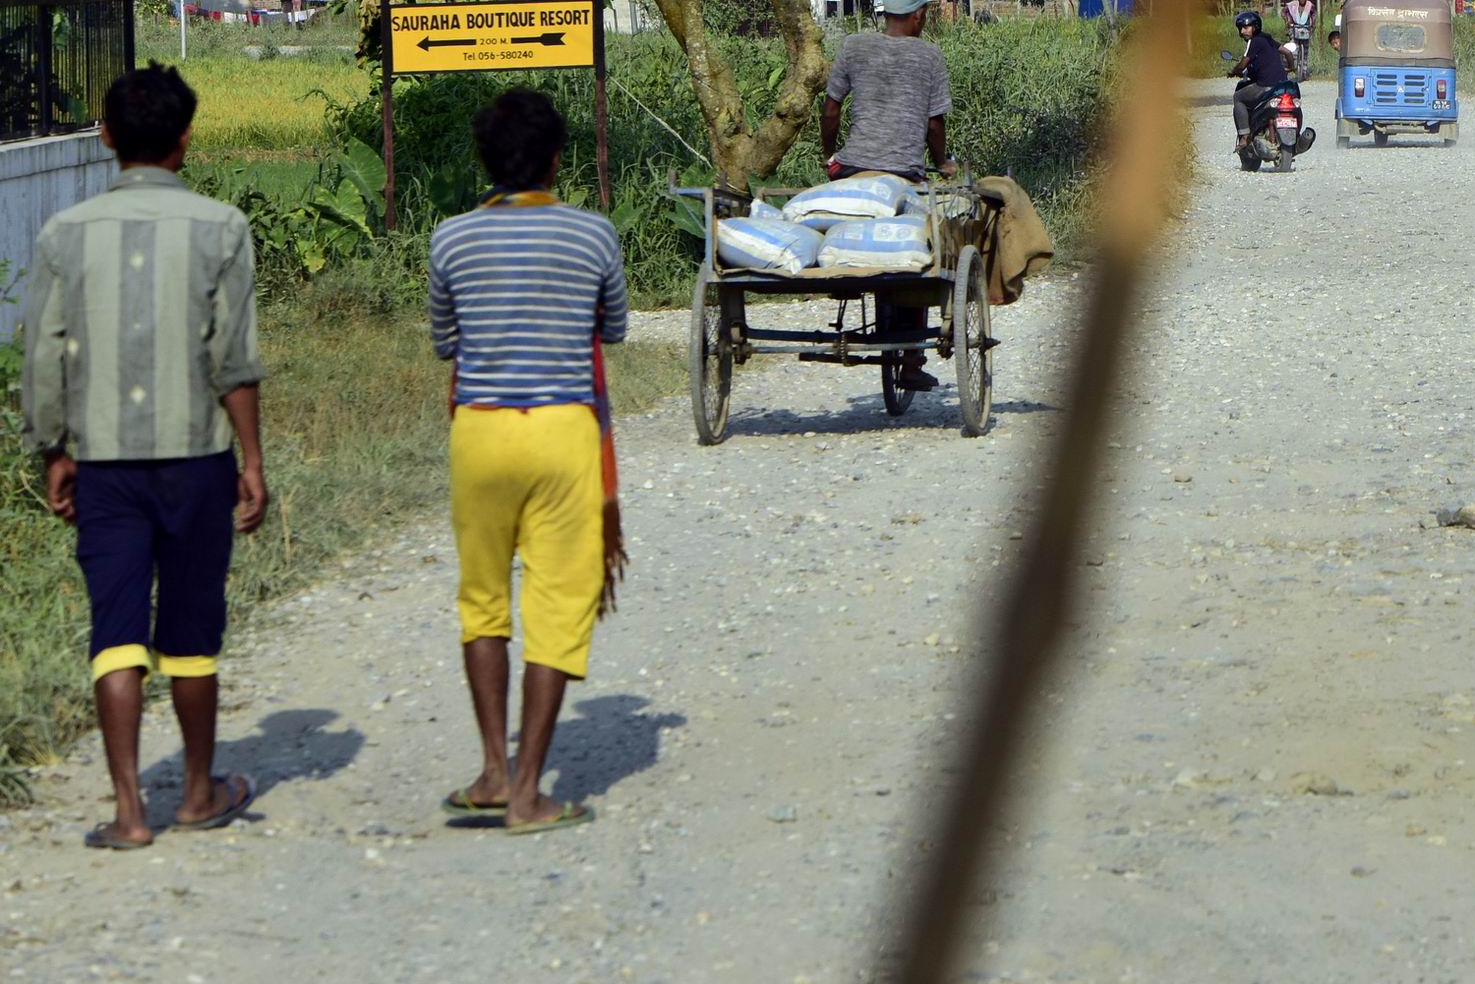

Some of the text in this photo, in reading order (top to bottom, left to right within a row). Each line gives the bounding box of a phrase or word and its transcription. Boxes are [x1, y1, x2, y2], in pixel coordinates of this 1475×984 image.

[392, 10, 590, 31] SAURAHA BOUTIQUE RESORT
[479, 51, 533, 60] 056-580240
